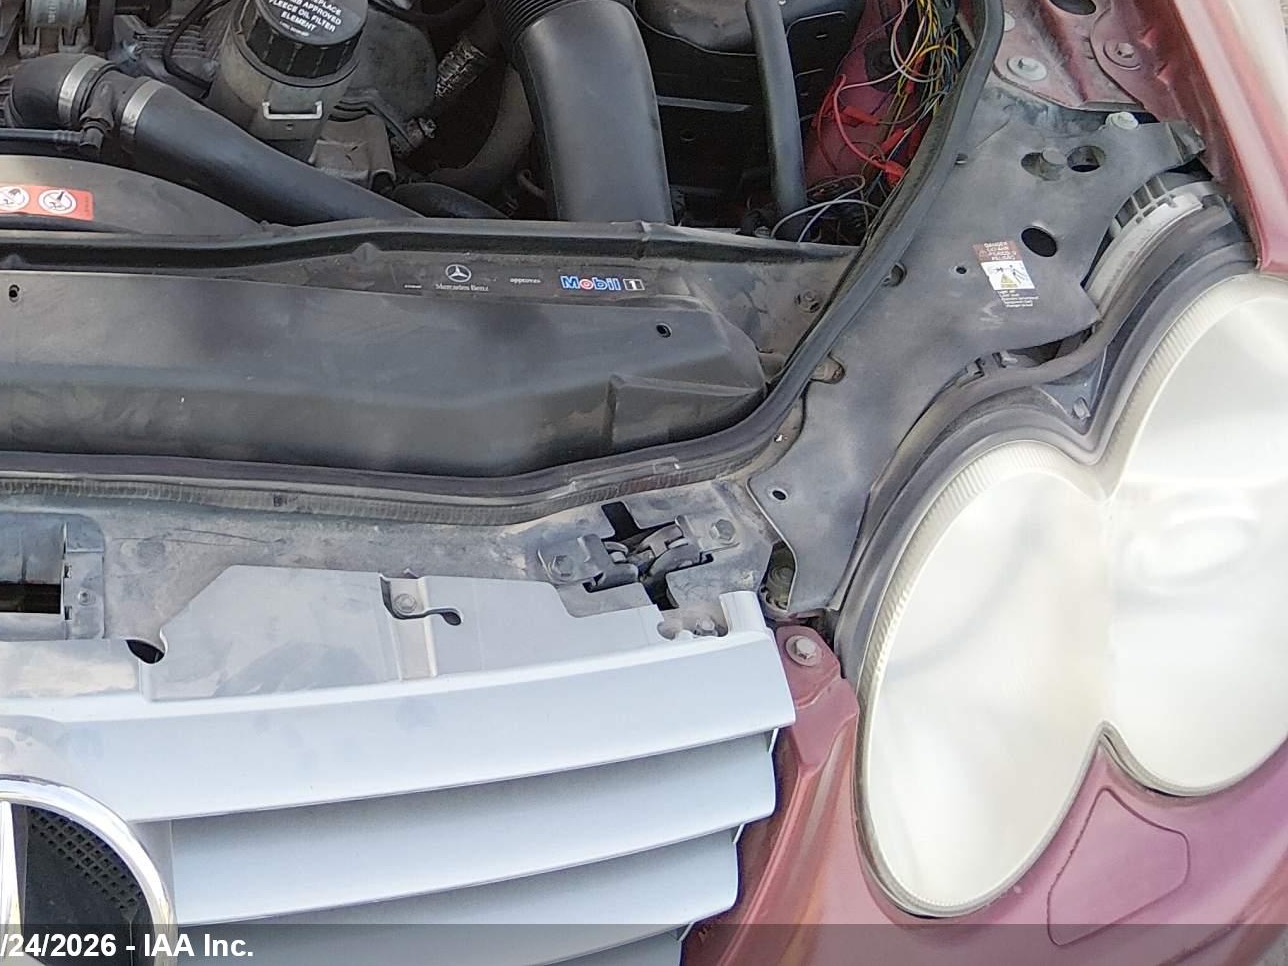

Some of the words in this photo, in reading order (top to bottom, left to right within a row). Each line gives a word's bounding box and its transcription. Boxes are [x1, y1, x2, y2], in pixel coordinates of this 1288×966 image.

[280, 10, 317, 32] ELEMENT
[297, 8, 311, 20] OIL
[310, 15, 337, 33] FILTER
[303, 1, 342, 26] APPROVED
[560, 275, 621, 291] Mobil
